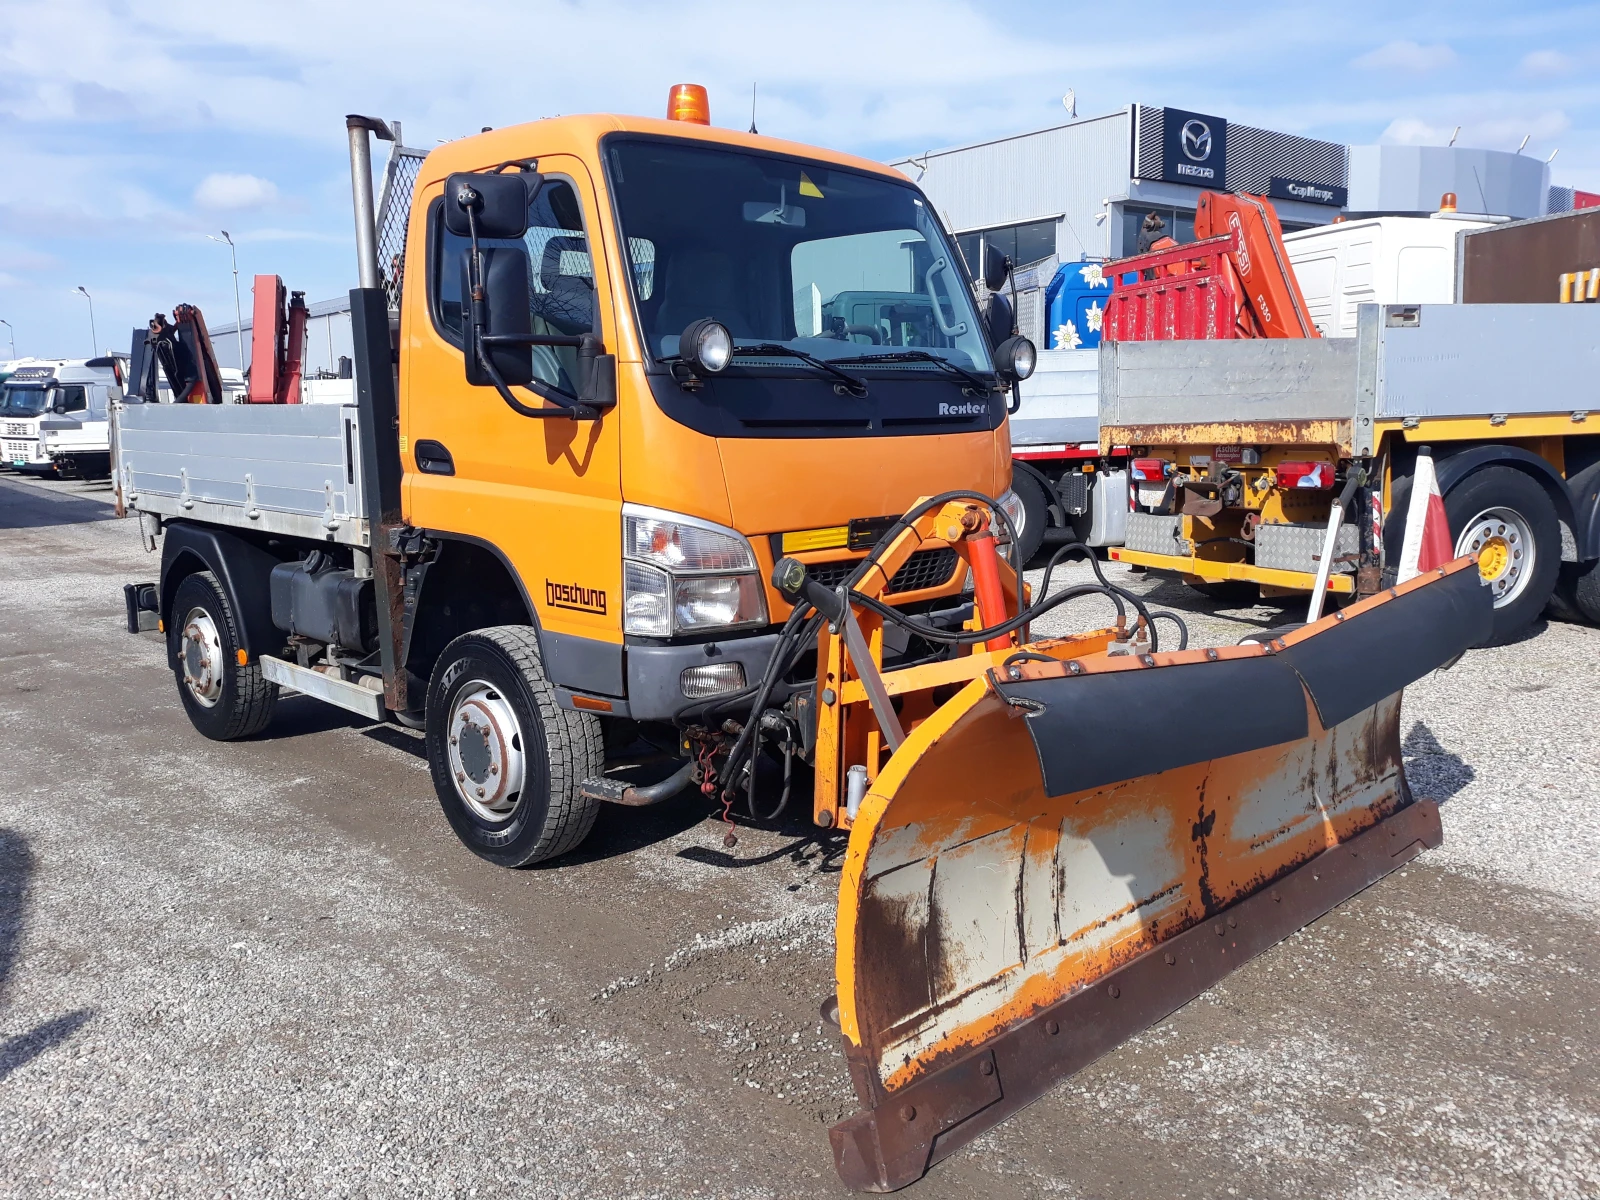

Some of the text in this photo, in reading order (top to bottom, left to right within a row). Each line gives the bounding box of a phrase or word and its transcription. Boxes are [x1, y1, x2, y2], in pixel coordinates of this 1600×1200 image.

[1178, 163, 1214, 179] mazda
[1257, 294, 1272, 322] F330
[938, 402, 986, 415] Rexter
[545, 578, 607, 616] boschung
